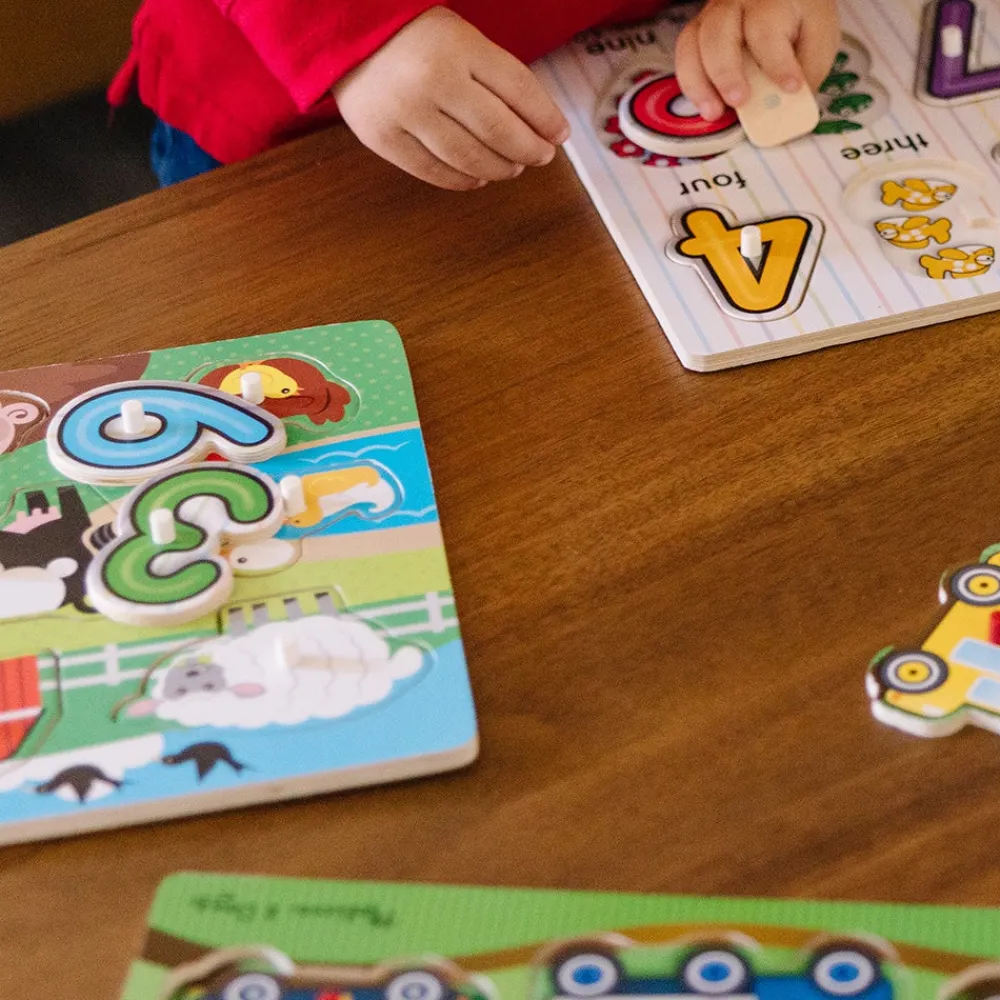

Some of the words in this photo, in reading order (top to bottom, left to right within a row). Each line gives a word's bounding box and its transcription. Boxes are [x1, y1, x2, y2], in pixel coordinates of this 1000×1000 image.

[842, 133, 928, 161] three
[681, 171, 746, 195] four
[676, 208, 812, 314] 4
